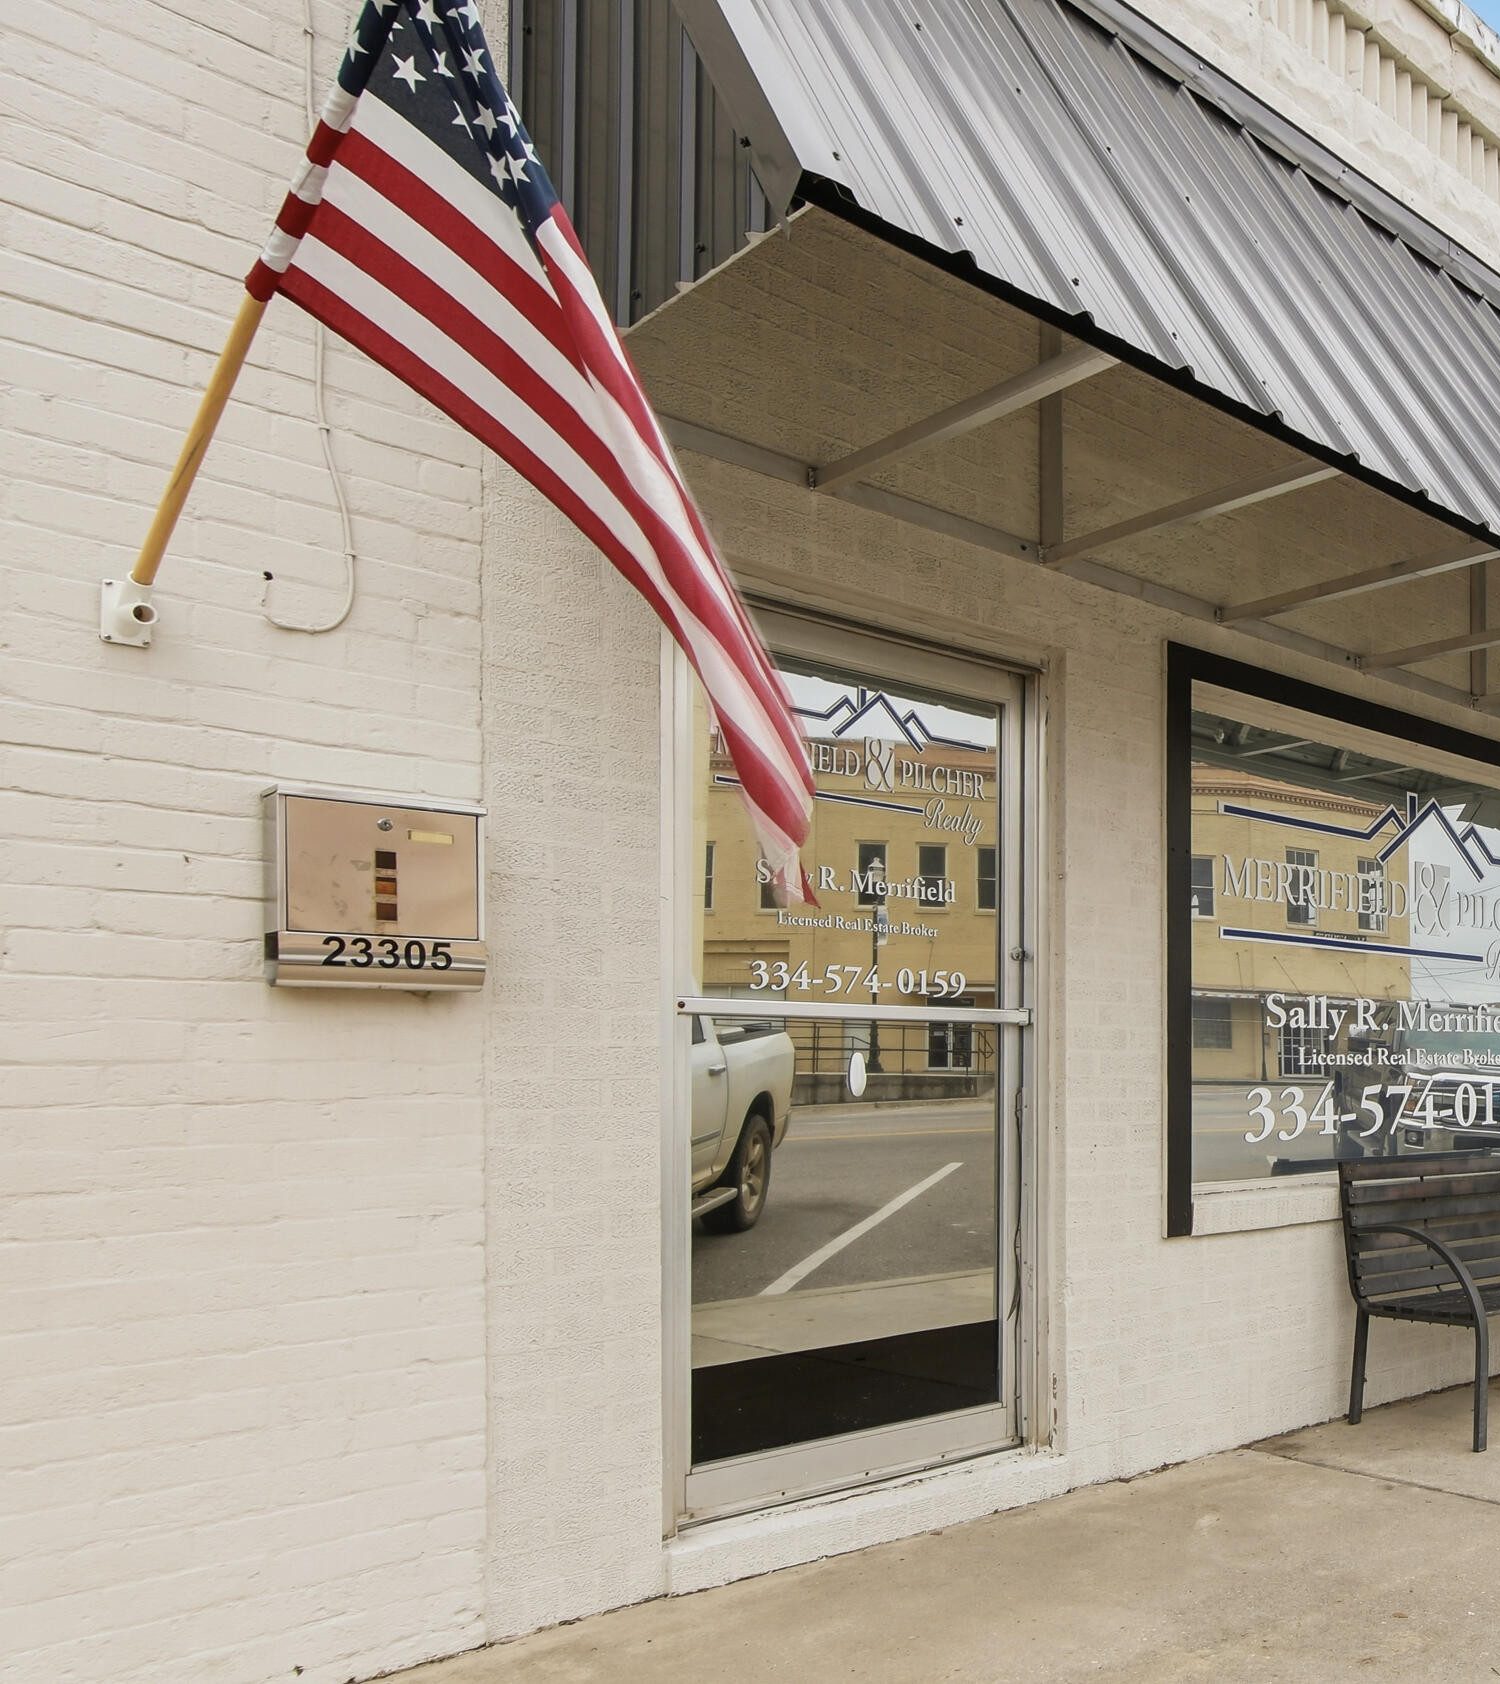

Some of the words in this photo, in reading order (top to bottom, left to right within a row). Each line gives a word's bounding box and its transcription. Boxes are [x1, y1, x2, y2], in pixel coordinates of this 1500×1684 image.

[900, 760, 985, 800] PILCHER
[924, 797, 983, 846] Realty
[819, 865, 844, 892] R.
[850, 869, 956, 903] Merrifield
[1222, 854, 1408, 918] MERRIFIELD
[778, 910, 832, 929] Licensed
[835, 917, 861, 931] Real
[864, 918, 899, 934] Estate
[902, 921, 938, 937] Broker
[322, 936, 453, 970] 23305
[749, 960, 966, 998] 334-574-0159
[1266, 993, 1348, 1040] Sally
[1354, 998, 1389, 1031] R.
[1298, 1046, 1372, 1066] Licensed
[1377, 1047, 1411, 1066] Real
[1416, 1048, 1459, 1065] Estate
